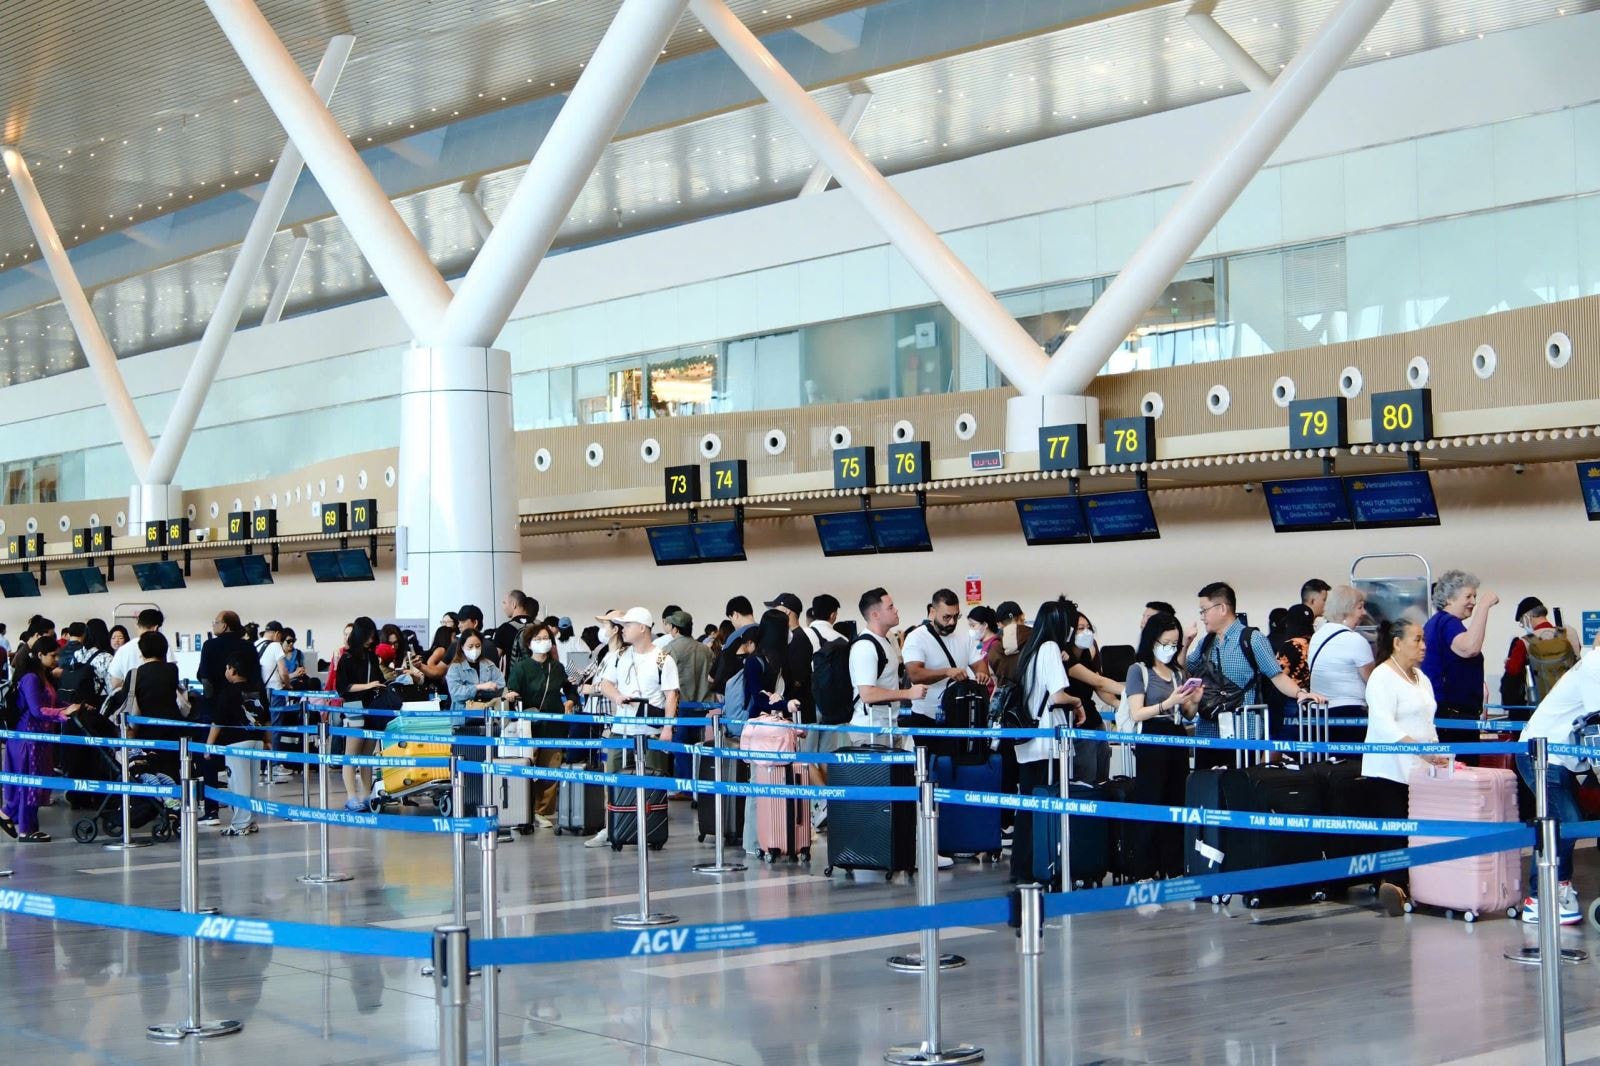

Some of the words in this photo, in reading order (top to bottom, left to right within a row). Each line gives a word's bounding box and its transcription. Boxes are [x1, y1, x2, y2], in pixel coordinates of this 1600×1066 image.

[1300, 410, 1328, 436] 79
[1383, 403, 1412, 431] 80
[1113, 429, 1138, 452] 78
[1047, 436, 1070, 459] 77
[841, 457, 860, 478] 75
[895, 453, 915, 474] 76
[671, 475, 687, 494] 73
[715, 470, 732, 489] 74
[325, 510, 336, 526] 69
[354, 507, 366, 522] 70
[231, 518, 241, 533] 67
[256, 516, 266, 531] 68
[148, 527, 157, 540] 65
[170, 525, 179, 538] 66
[28, 538, 35, 551] 62
[94, 532, 102, 545] 64
[10, 542, 17, 553] 61
[592, 715, 605, 723] TIA
[1476, 721, 1491, 729] TIA
[85, 736, 94, 744] TIA
[363, 730, 373, 738] TIA
[1061, 730, 1076, 738] TIA
[495, 737, 505, 745] TIA
[1273, 741, 1290, 751] TIA
[205, 744, 217, 753] TIA
[684, 744, 700, 754] TIA
[1354, 744, 1371, 752] NHAT
[1592, 747, 1600, 756] SƠ
[318, 754, 331, 764] TIA
[836, 753, 855, 763] TIA
[481, 764, 495, 774] TIA
[74, 780, 88, 791] TIA
[675, 779, 692, 791] TIA
[726, 784, 739, 793] TAN
[739, 785, 752, 794] SON
[753, 785, 769, 794] NHAT
[770, 787, 817, 797] INTERNATIONAL
[818, 788, 846, 798] AIRPORT
[251, 800, 264, 813] TIA
[1169, 807, 1202, 824] TIA
[432, 818, 450, 832] TIA
[1250, 815, 1265, 825] TAN
[1268, 816, 1284, 827] SON
[1286, 817, 1309, 828] NHAT
[1312, 818, 1378, 831] INTERNATIONAL
[1381, 820, 1418, 832] AIRPORT
[1349, 854, 1376, 875] ACV
[1125, 883, 1161, 906] ACV
[195, 916, 236, 939] ACV
[631, 928, 689, 955] ACV
